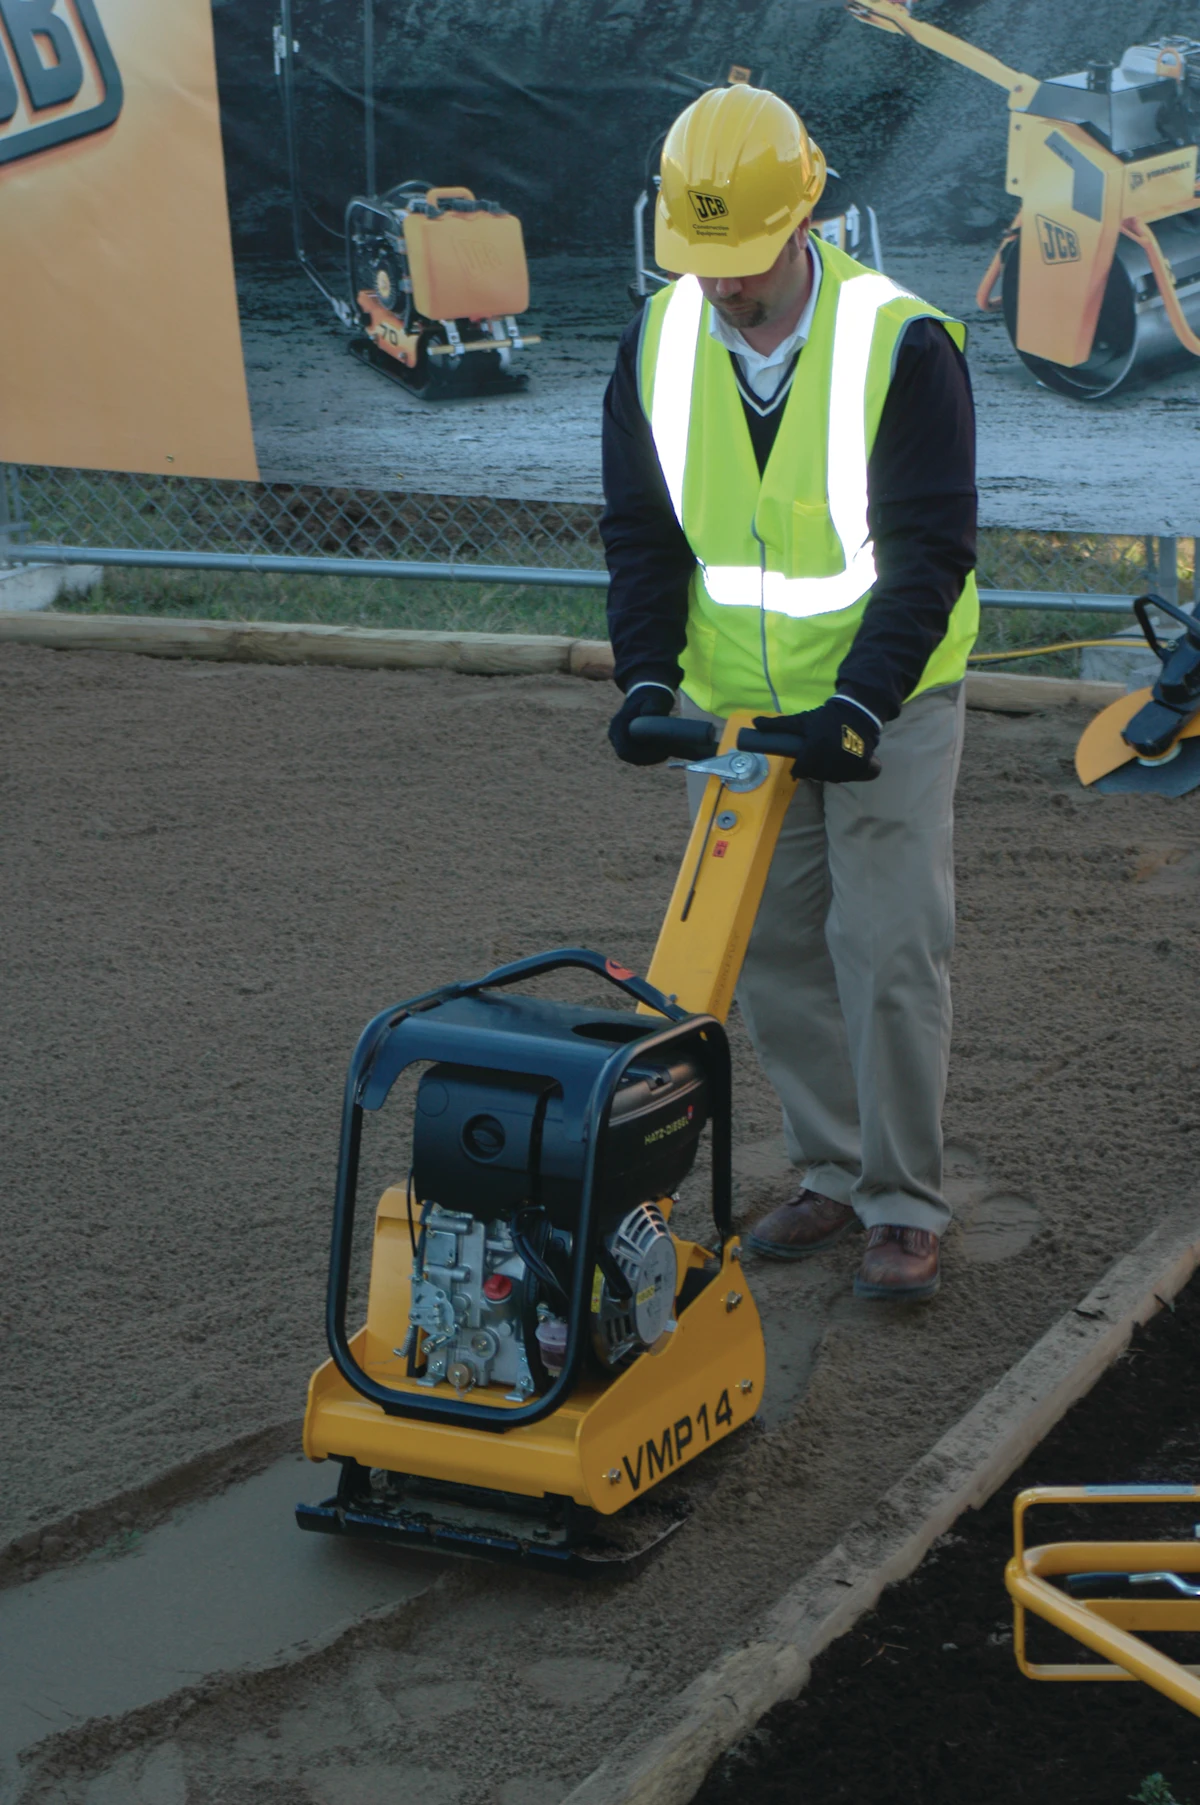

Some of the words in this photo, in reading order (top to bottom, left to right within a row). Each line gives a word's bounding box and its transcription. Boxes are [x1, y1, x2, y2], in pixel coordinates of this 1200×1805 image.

[695, 194, 726, 219] JCB
[1043, 221, 1078, 260] JCB
[379, 324, 399, 347] 70
[844, 729, 864, 755] JCB
[621, 1387, 734, 1493] VMP14
